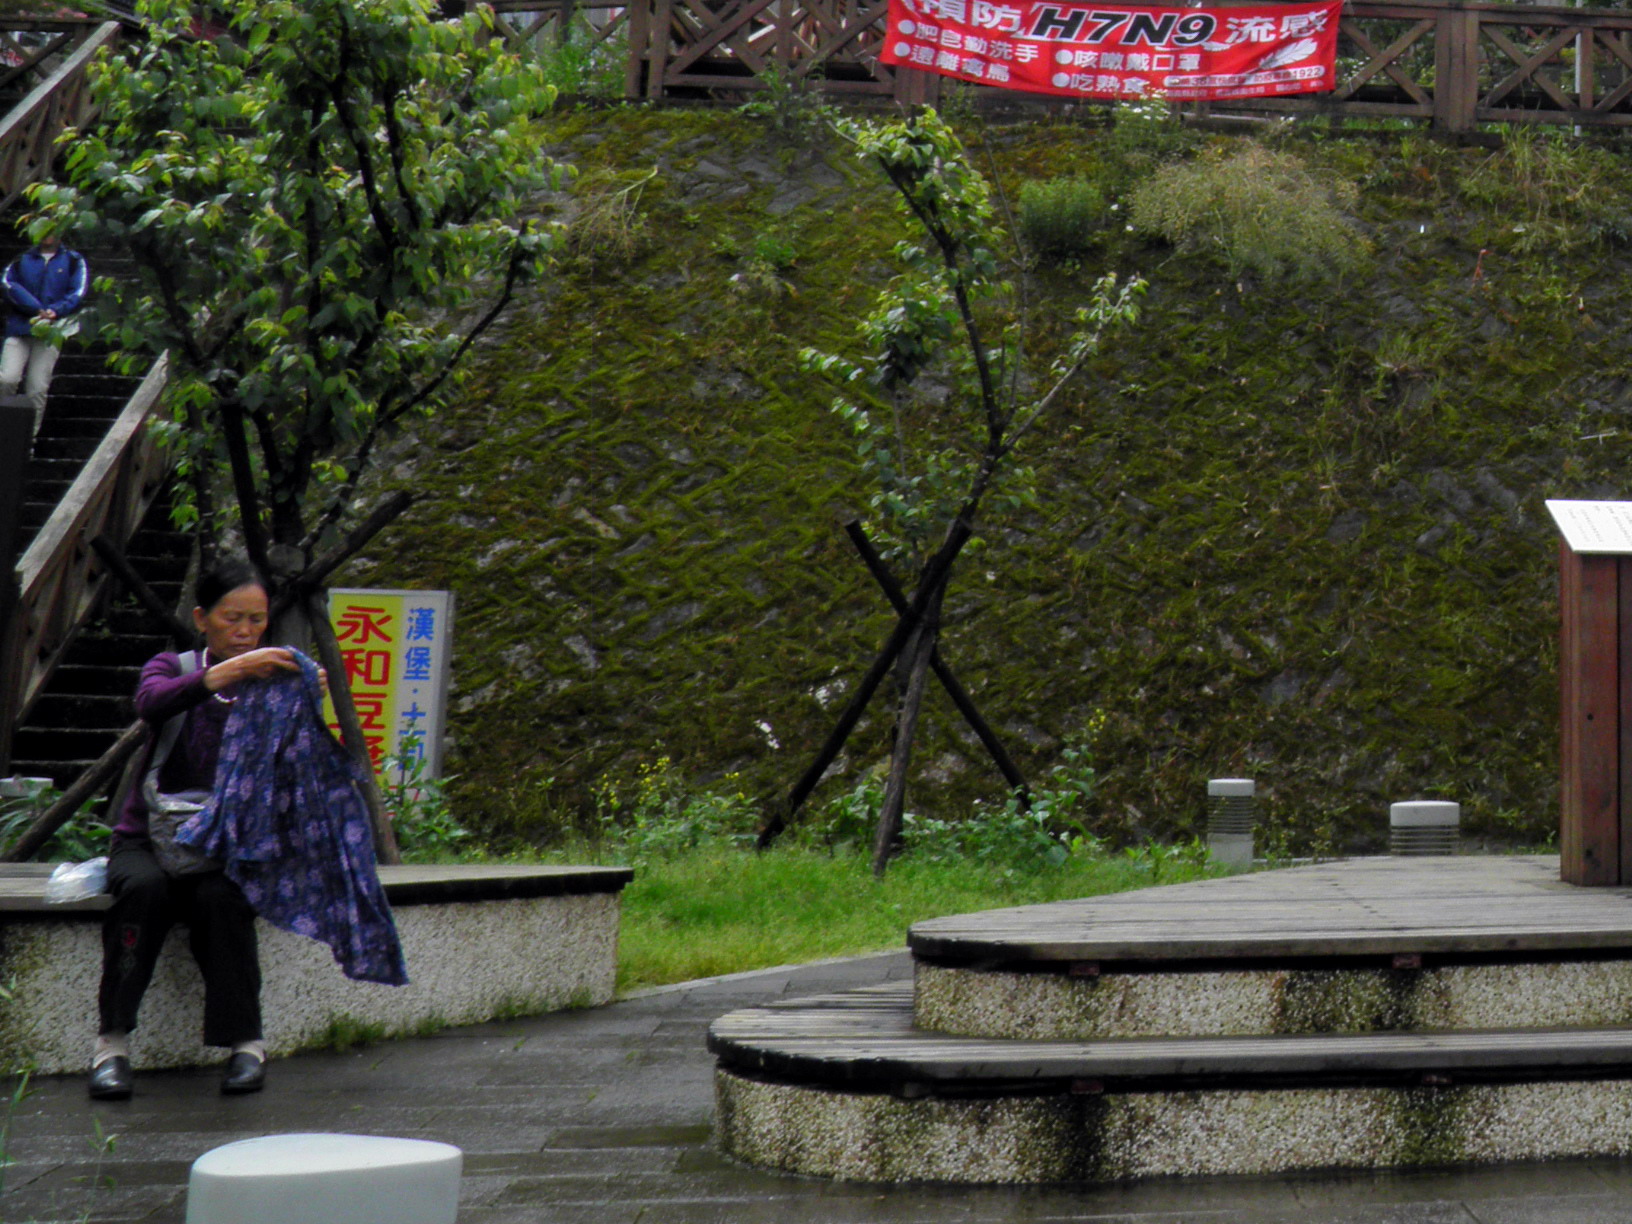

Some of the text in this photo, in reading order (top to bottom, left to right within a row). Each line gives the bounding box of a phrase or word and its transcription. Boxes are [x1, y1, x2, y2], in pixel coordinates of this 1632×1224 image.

[915, 22, 1039, 63] 肥皂勤洗手
[910, 44, 1010, 83] 遠離禽鳥
[1073, 50, 1200, 72] 咳嗽戴口罩
[1070, 72, 1149, 95] 吃熱食
